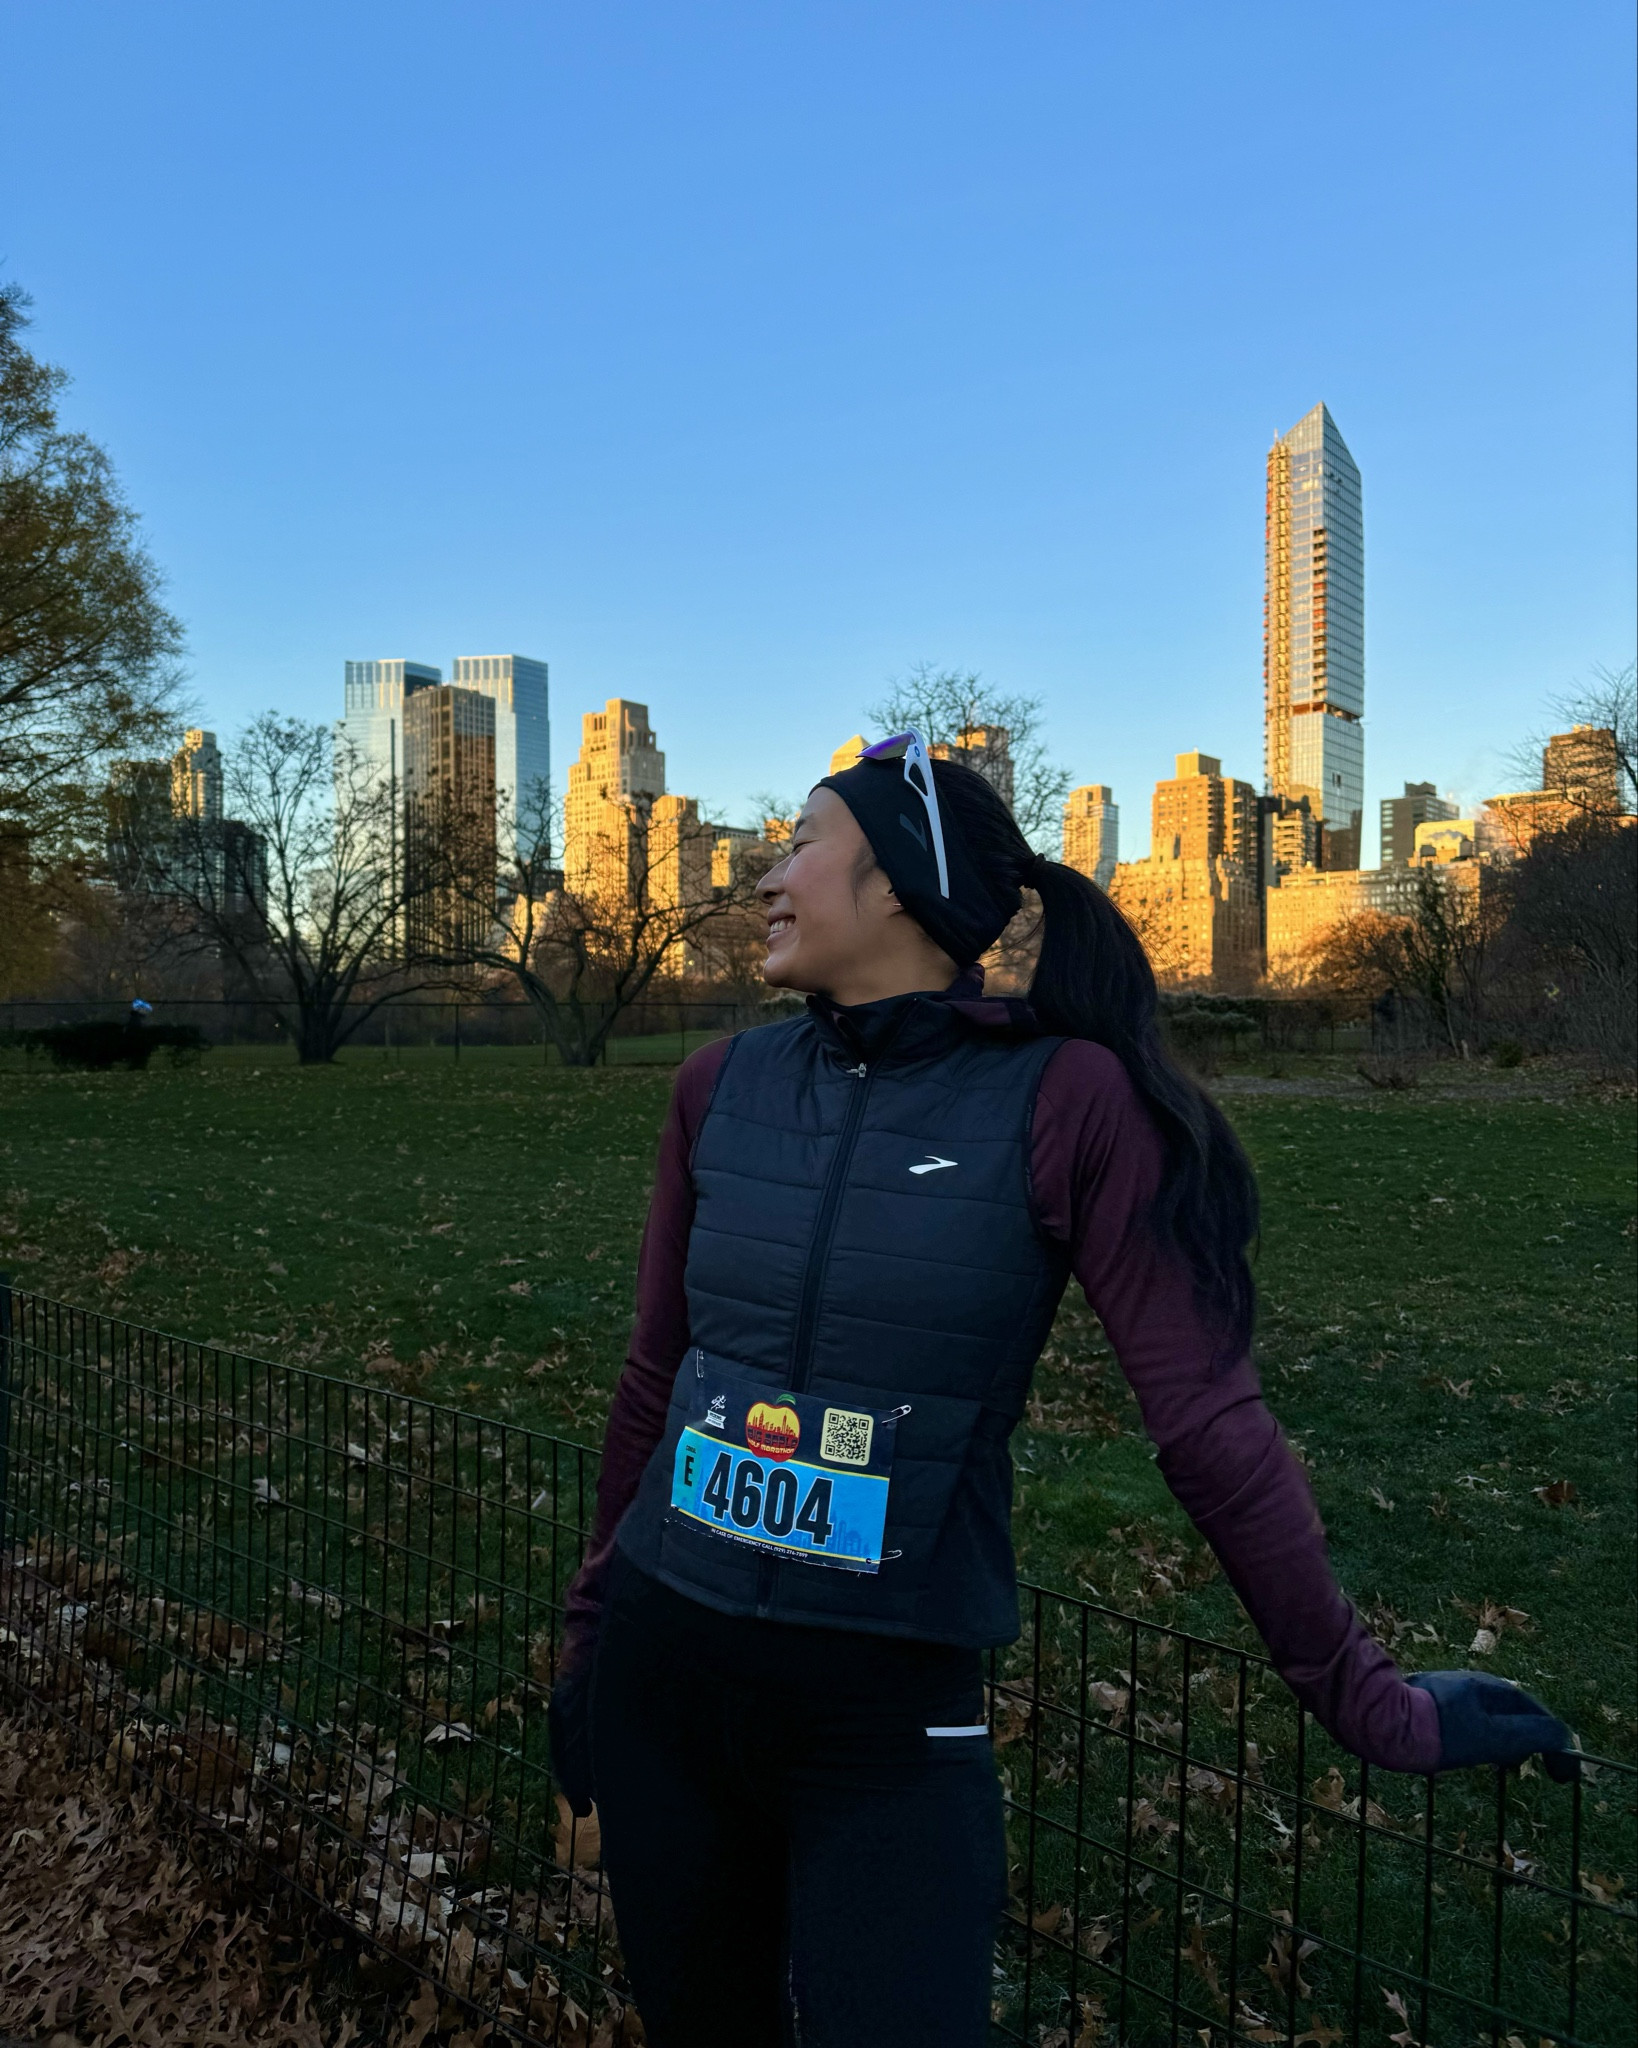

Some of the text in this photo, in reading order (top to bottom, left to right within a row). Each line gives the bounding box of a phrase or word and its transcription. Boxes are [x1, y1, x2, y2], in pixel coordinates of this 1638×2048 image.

[747, 1427, 798, 1448] BIG APPLE
[684, 1455, 695, 1487] E
[702, 1450, 834, 1547] 4604
[734, 1536, 761, 1547] EMERGENCY
